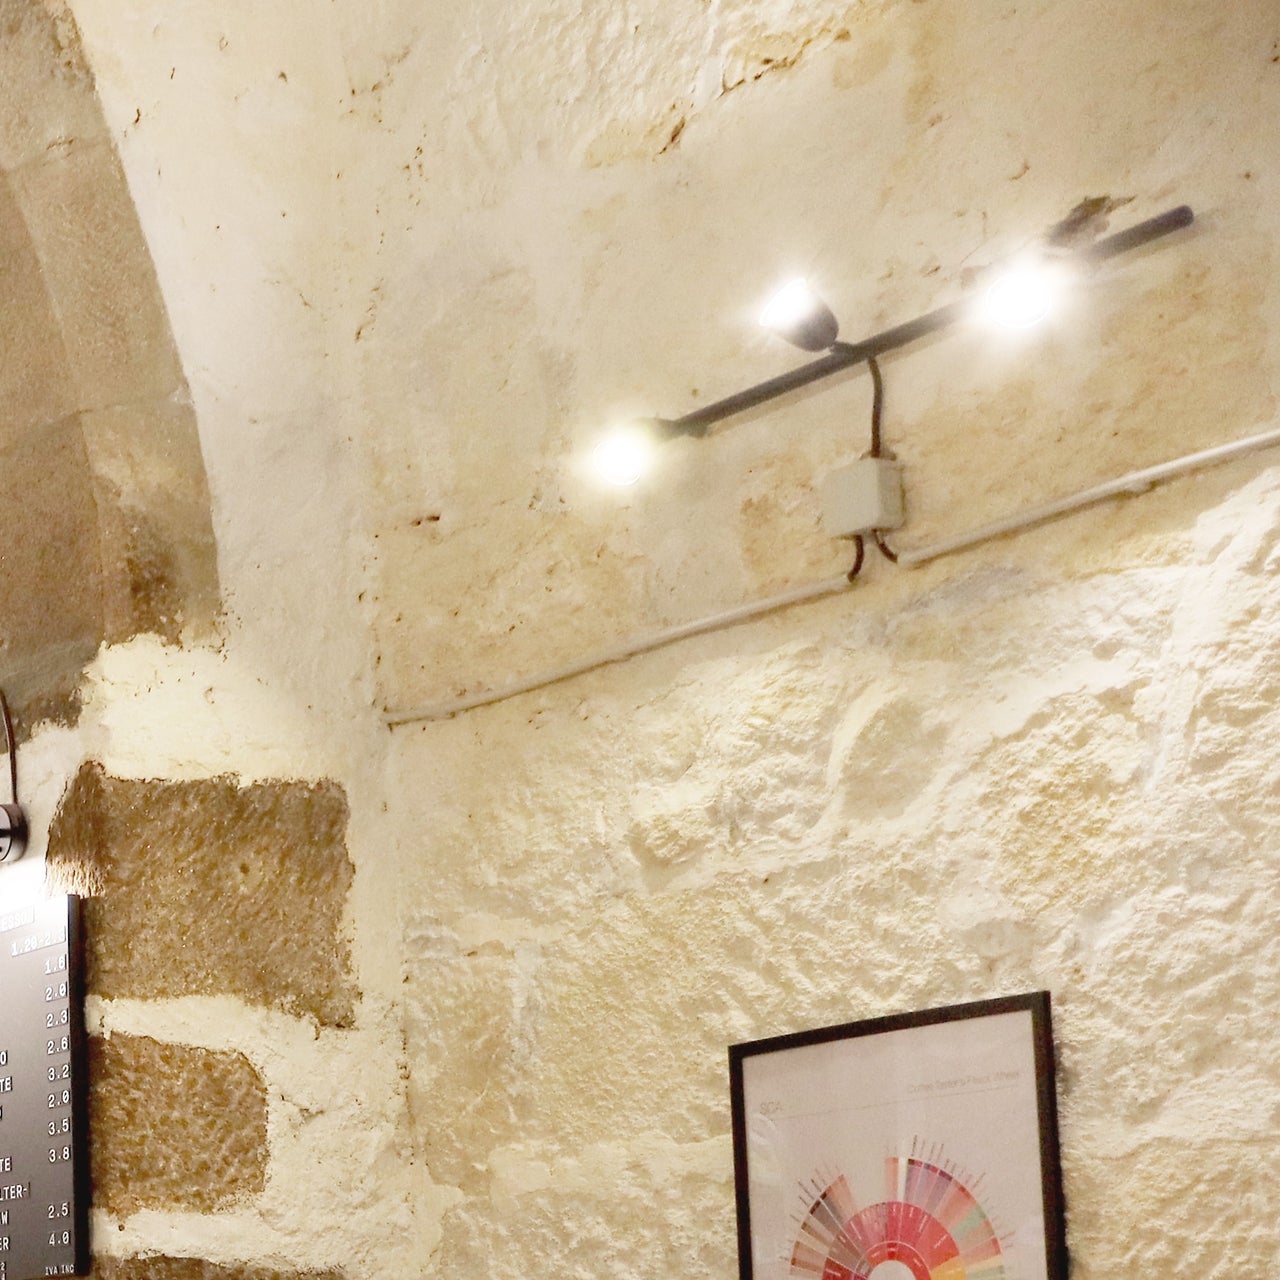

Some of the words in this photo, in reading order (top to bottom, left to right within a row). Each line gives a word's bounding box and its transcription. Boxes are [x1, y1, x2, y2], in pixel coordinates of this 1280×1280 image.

[44, 956, 66, 975] 1.6
[45, 983, 67, 1001] 2.0
[46, 1009, 68, 1028] 2.3
[47, 1036, 68, 1055] 2.6
[48, 1064, 69, 1081] 3.2
[48, 1090, 70, 1108] 2.0
[48, 1118, 69, 1136] 3.5
[49, 1146, 70, 1163] 3.8
[48, 1202, 69, 1219] 2.5
[49, 1231, 70, 1246] 4.0
[45, 1267, 58, 1276] IVA
[61, 1264, 75, 1274] INC
